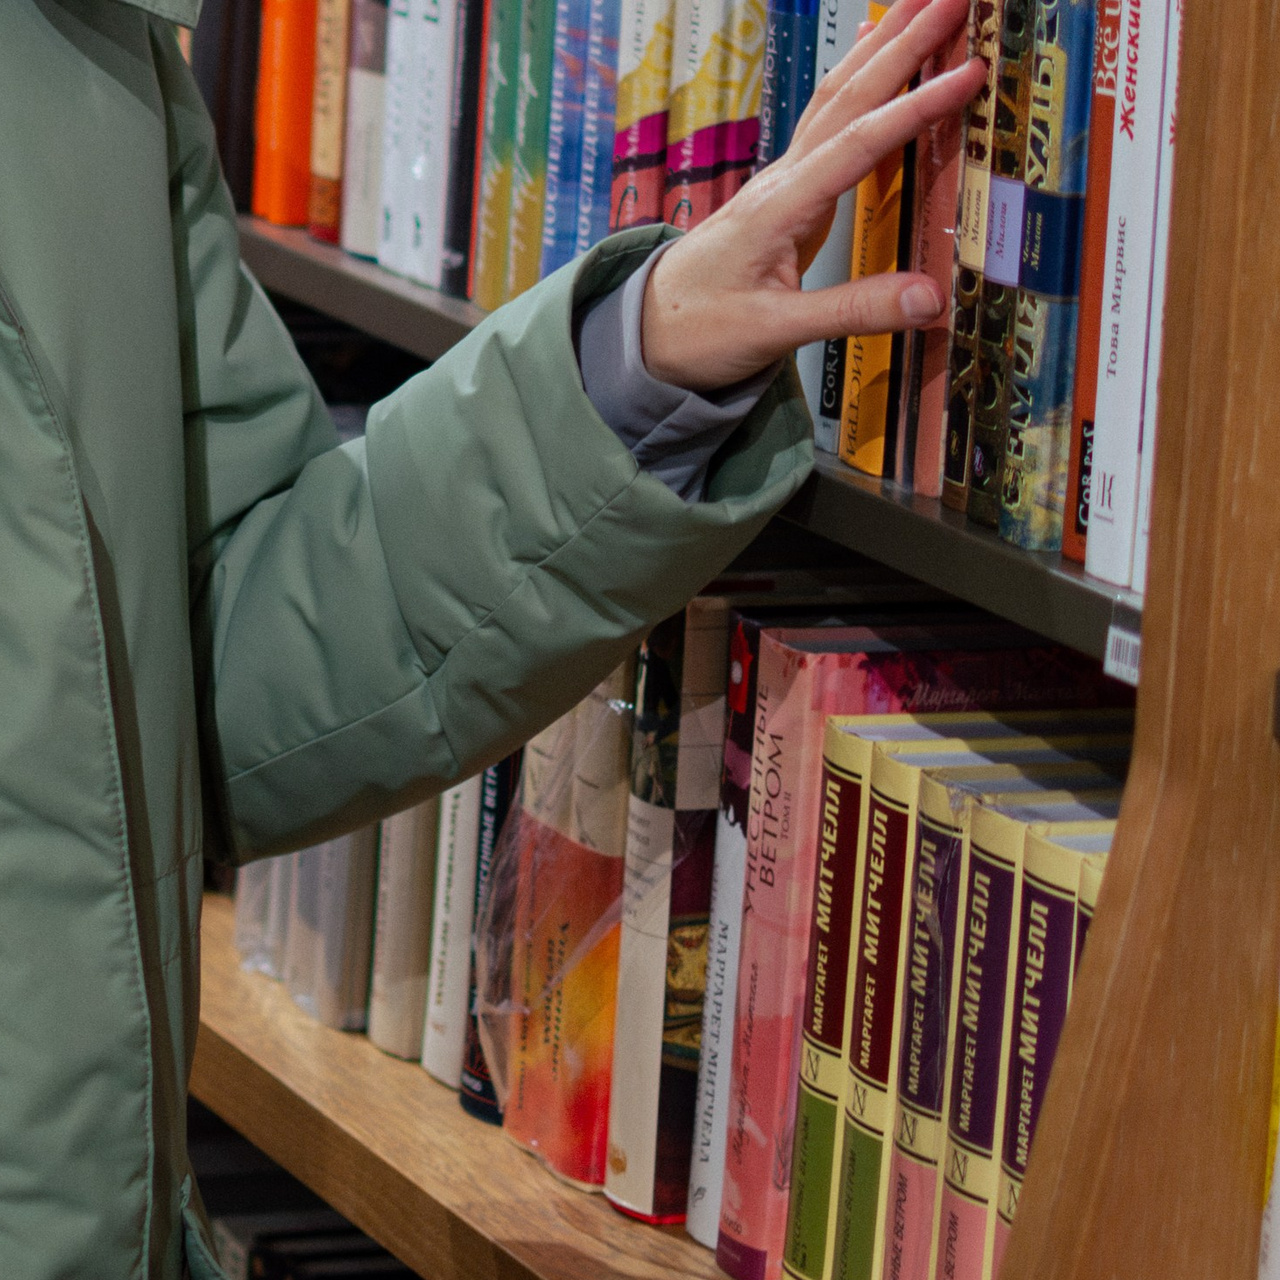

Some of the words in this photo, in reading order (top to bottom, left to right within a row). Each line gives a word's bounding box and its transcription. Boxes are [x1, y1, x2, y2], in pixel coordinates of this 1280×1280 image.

[757, 22, 778, 163] Нью-Йорк
[1095, 26, 1120, 100] Всё
[541, 66, 565, 247] ПОСЛЕДНЕЕ
[575, 71, 600, 253] ПОСЛЕДНЕЕ
[859, 206, 874, 277] Рохин
[970, 188, 982, 246] Милош
[994, 201, 1008, 259] Милош
[1030, 211, 1043, 271] Милош
[1109, 214, 1128, 316] Мирвис
[845, 336, 864, 457] МИСТРИ
[1105, 321, 1120, 380] Това
[484, 761, 500, 809] ВЕТР
[742, 683, 768, 914] УНЕСЕННЫЕ
[758, 732, 784, 888] ВЕТРОМ
[780, 804, 791, 841] ТОМ
[815, 777, 841, 933] МИТЧЕЛЛ
[863, 808, 888, 966] МИТЧЕЛЛ
[910, 837, 937, 997] МИТЧЕЛЛ
[962, 870, 991, 1033] МИТЧЕЛЛ
[709, 919, 731, 1045] МАРГАРЕТ
[811, 940, 829, 1035] МАРГАРЕТ
[860, 973, 876, 1069] МАРГАРЕТ
[1018, 899, 1049, 1066] МИТЧЕЛЛ
[907, 998, 925, 1096] МАРГАРЕТ
[958, 1033, 977, 1133] МАРГАРЕТ
[698, 1047, 720, 1165] МИТЧЕЛЛ
[1015, 1066, 1035, 1167] МАРГАРЕТ
[893, 1172, 908, 1240] ВЕТРОМ
[944, 1211, 960, 1280] ВЕТРОМ
